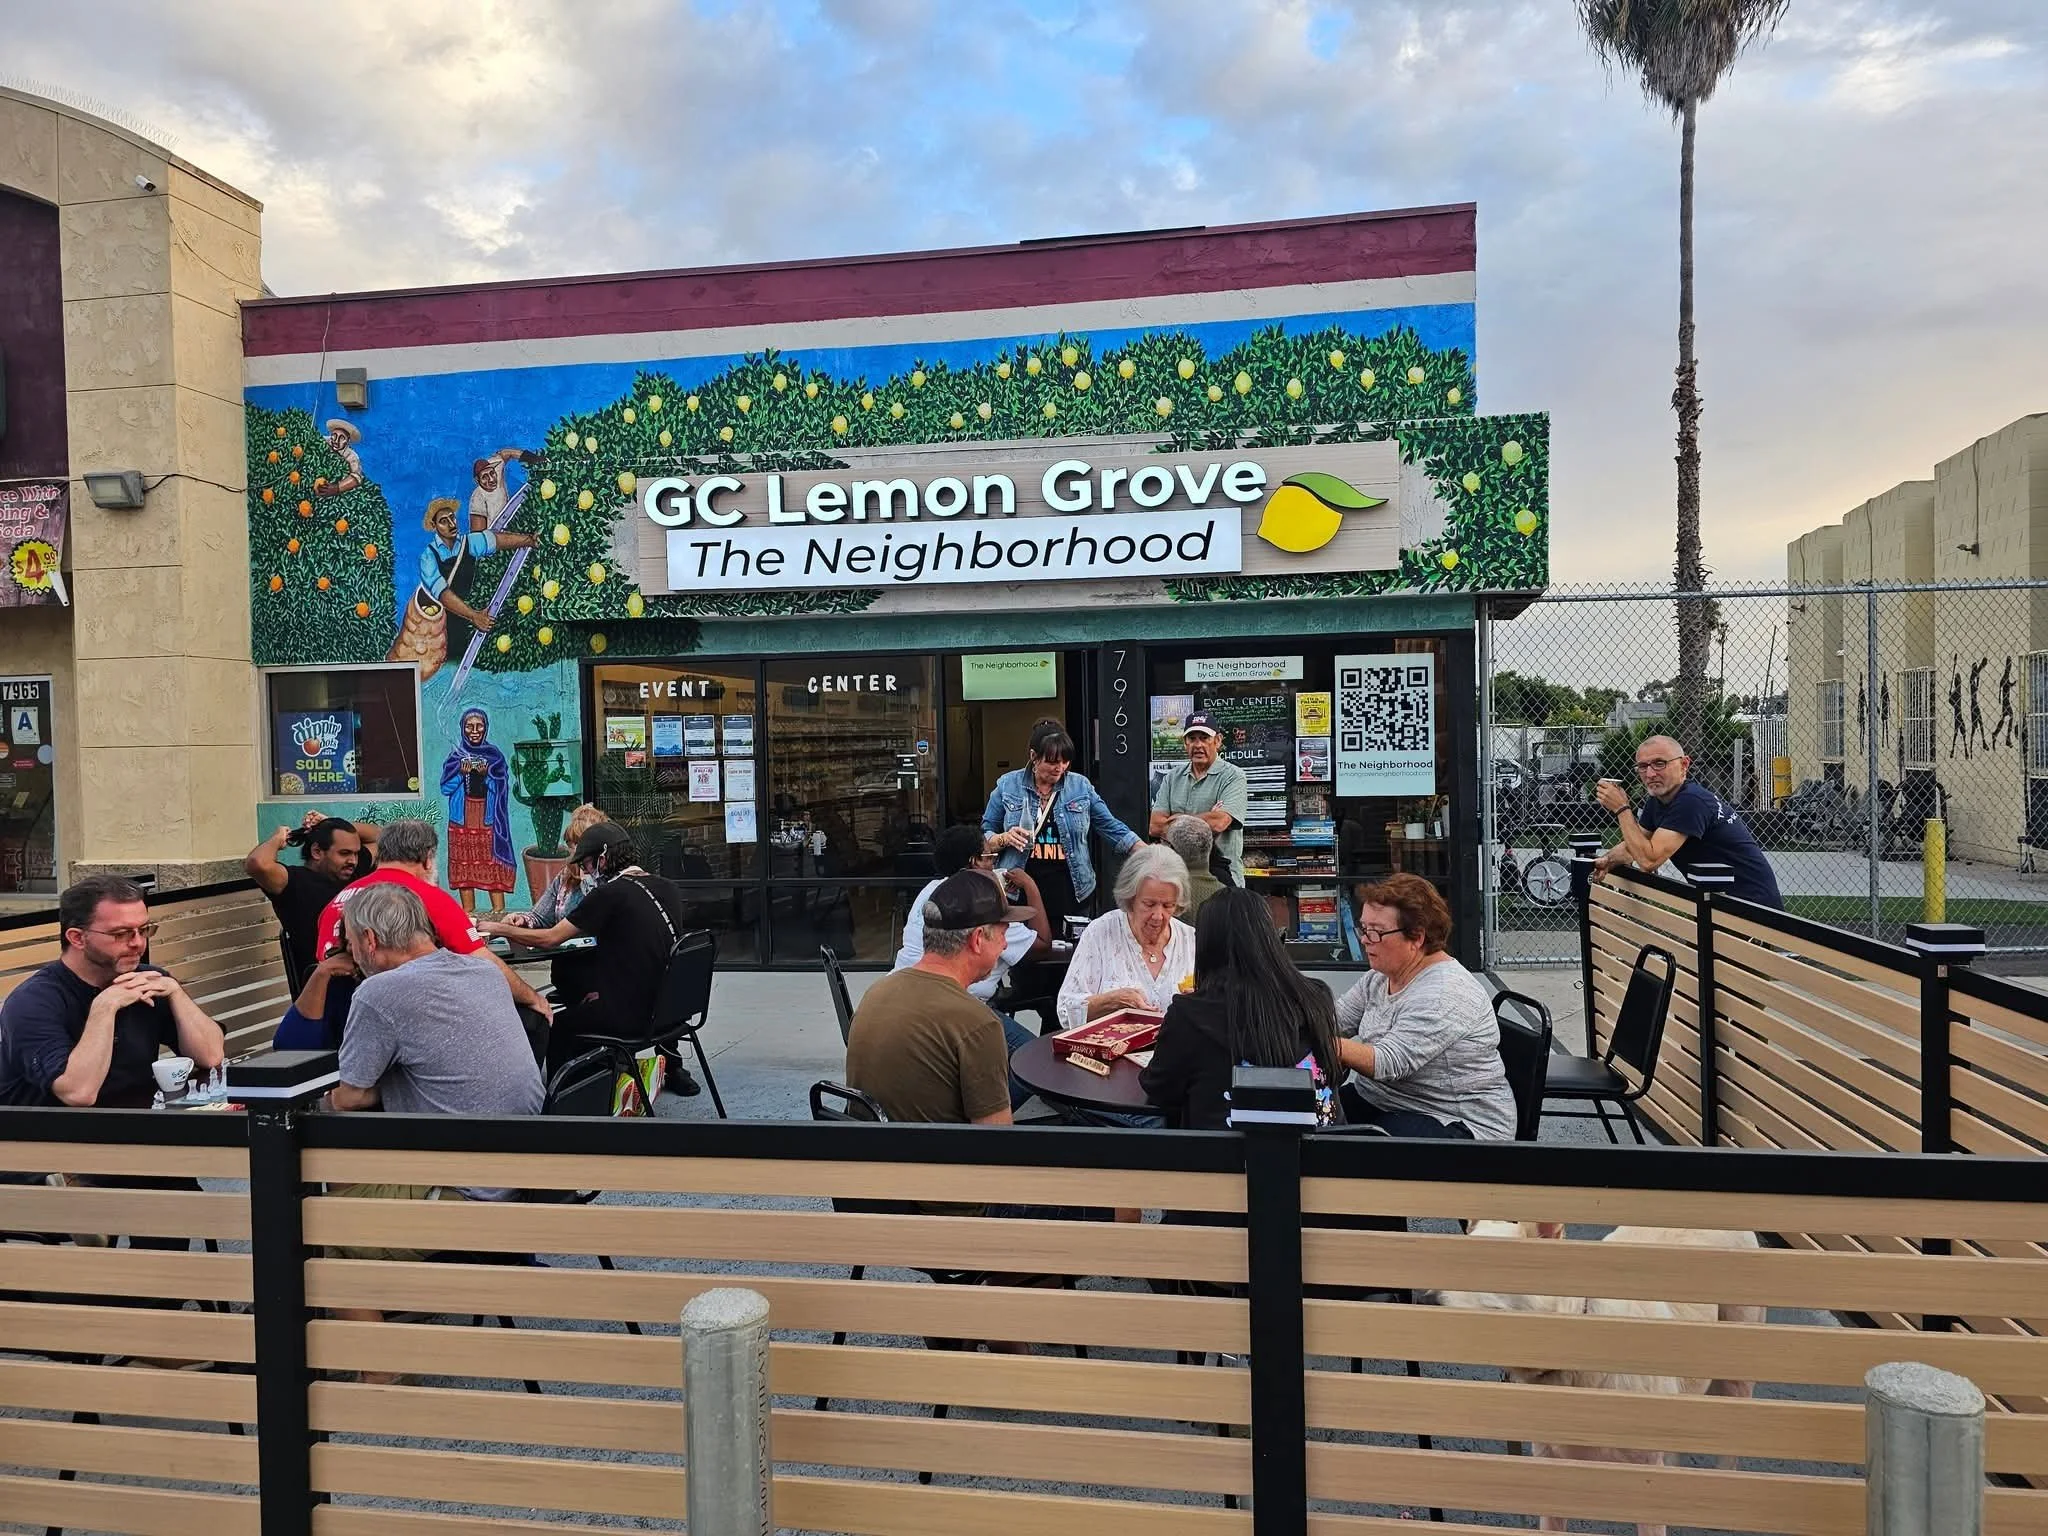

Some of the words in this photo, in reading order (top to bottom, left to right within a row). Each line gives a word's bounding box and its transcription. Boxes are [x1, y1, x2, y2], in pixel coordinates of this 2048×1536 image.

[644, 475, 746, 527] GC
[767, 473, 1017, 526] Lemon
[1041, 459, 1268, 512] Grove
[34, 503, 49, 518] &
[690, 539, 785, 578] The
[804, 521, 1215, 582] Neighborhood
[985, 660, 1038, 670] Neighborhood
[1217, 660, 1286, 670] Neighborhood
[1197, 671, 1206, 679] by
[1249, 669, 1272, 677] Grove
[3, 683, 39, 699] 7965
[639, 680, 710, 699] EVENT
[808, 674, 897, 693] CENTER
[1113, 650, 1128, 754] 7963
[1203, 698, 1235, 708] EVENT
[1242, 696, 1286, 706] CENTER
[18, 711, 33, 730] A
[1217, 749, 1269, 760] CHEDULE:
[295, 759, 332, 770] SOLD
[1337, 761, 1357, 769] The
[1359, 760, 1433, 770] Neighborhood
[308, 771, 345, 783] HERE
